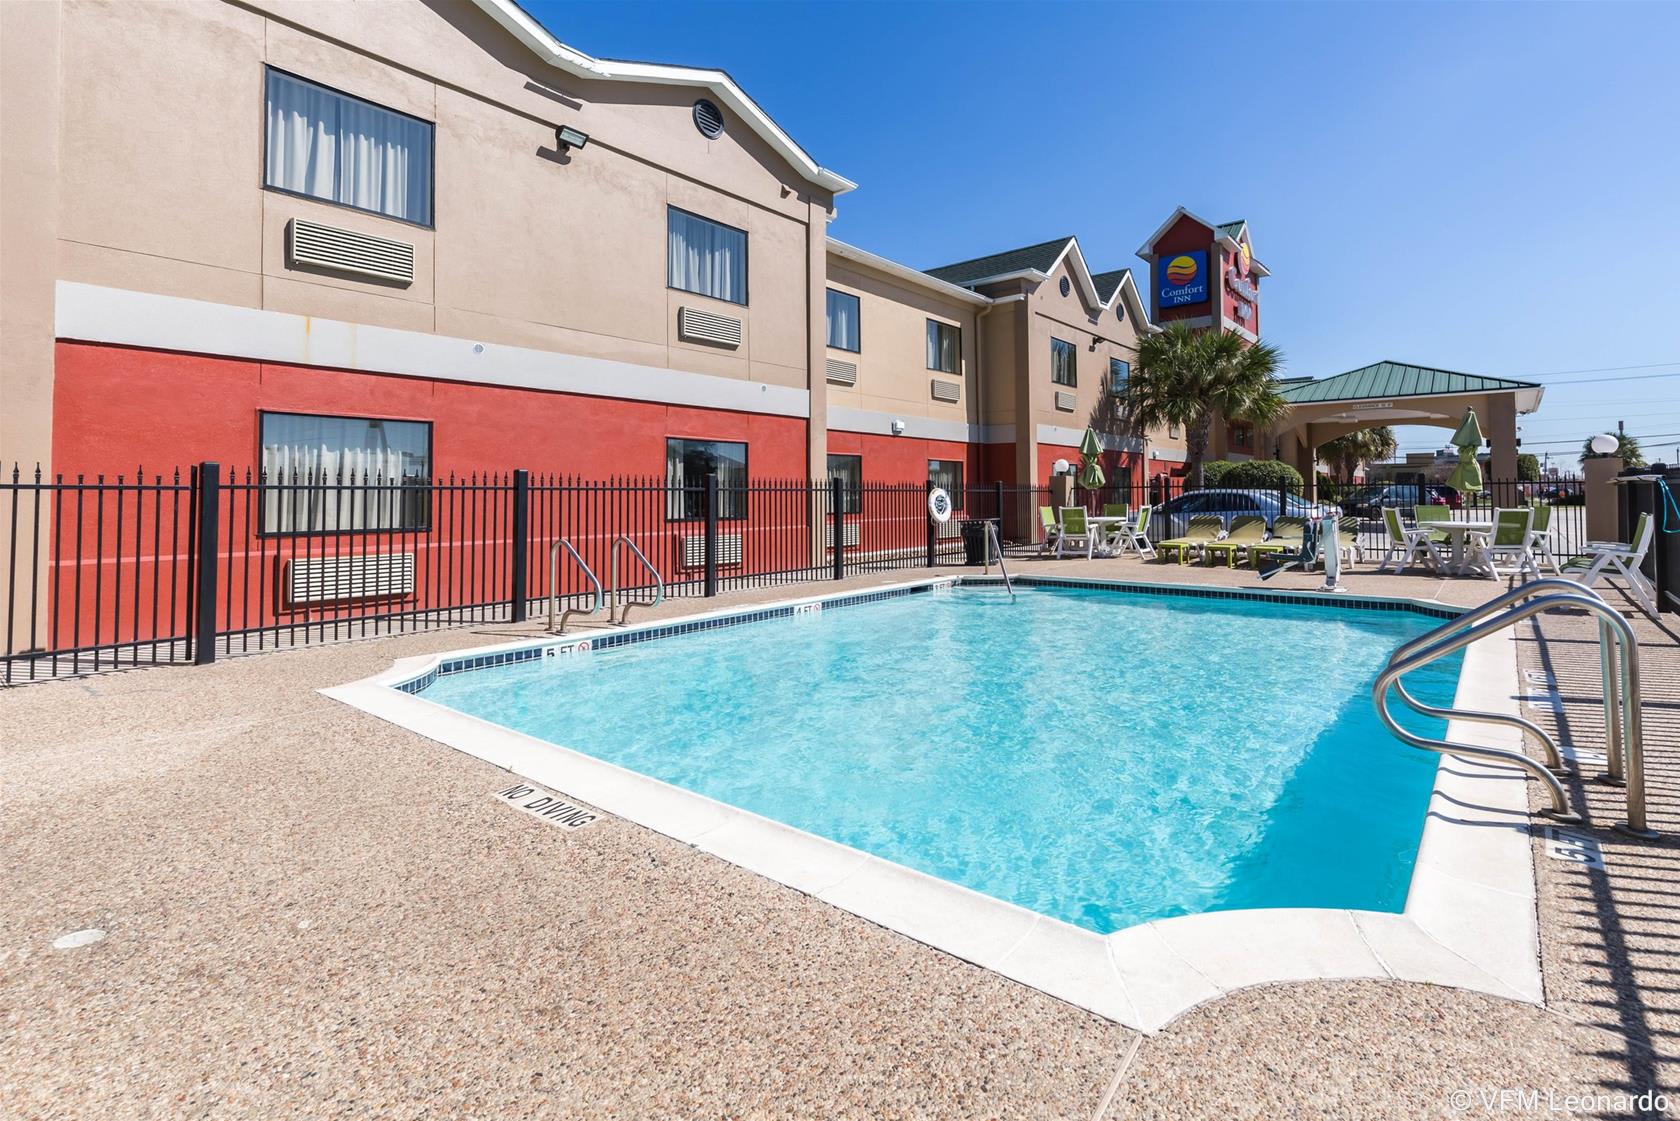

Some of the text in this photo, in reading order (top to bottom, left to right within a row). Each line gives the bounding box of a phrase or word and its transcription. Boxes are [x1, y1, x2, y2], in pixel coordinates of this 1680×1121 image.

[1161, 283, 1203, 298] Comfort
[1173, 295, 1191, 304] INN
[804, 605, 812, 613] FT
[547, 644, 574, 657] 5 FT
[497, 784, 597, 827] NO DIVING
[1551, 828, 1596, 862] 5 FT
